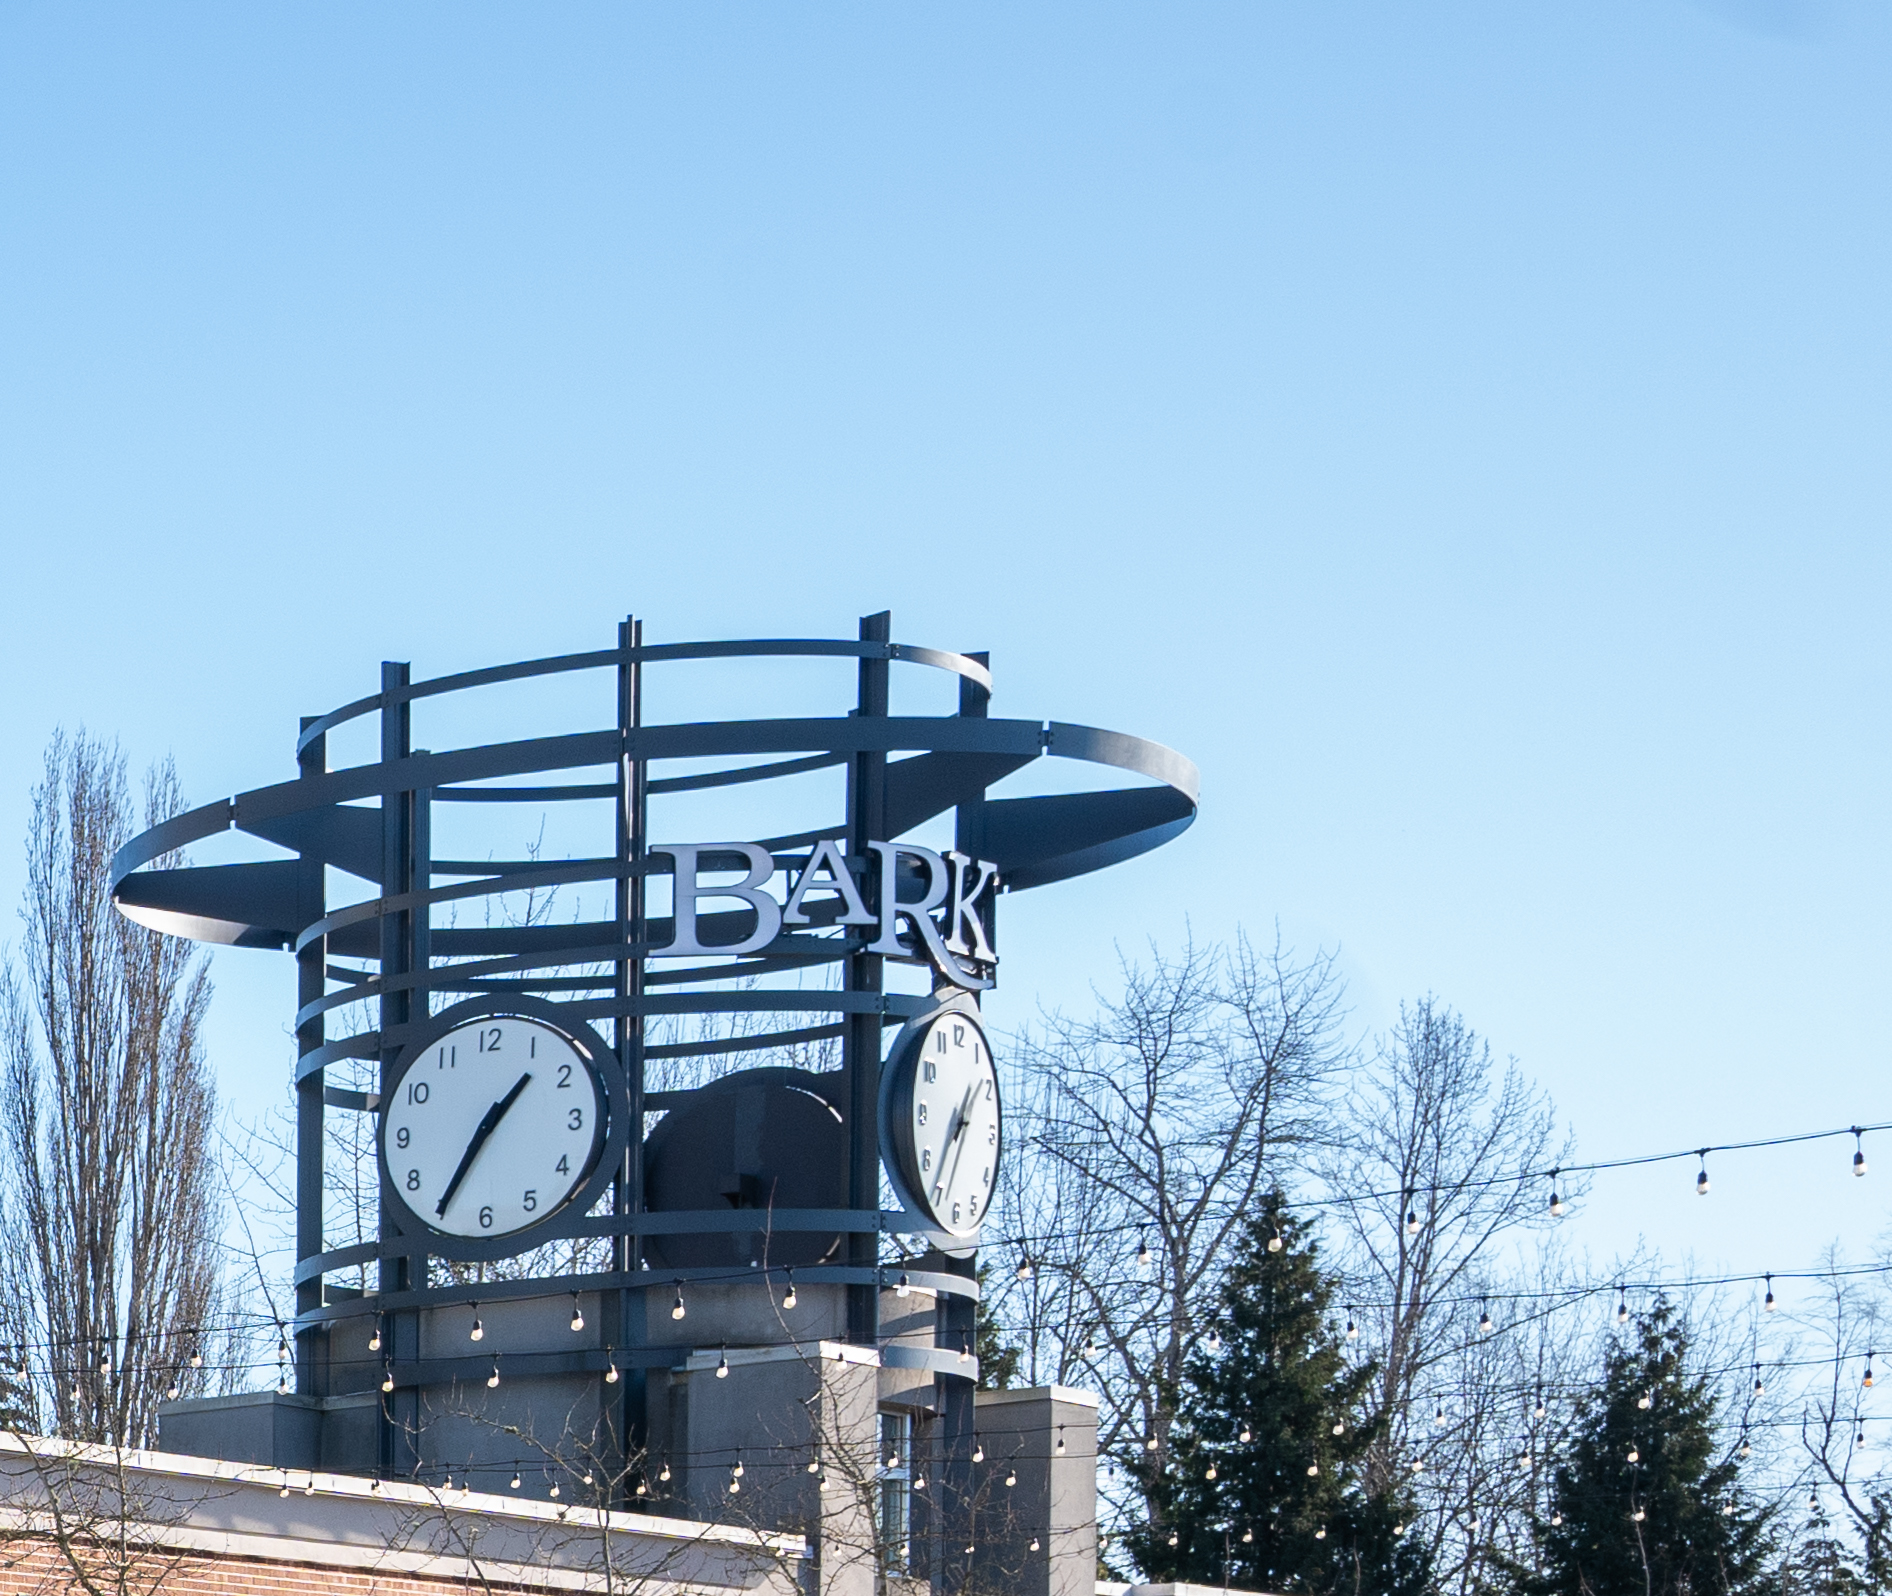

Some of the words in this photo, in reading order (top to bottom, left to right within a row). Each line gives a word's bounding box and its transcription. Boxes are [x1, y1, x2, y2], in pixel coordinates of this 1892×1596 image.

[648, 839, 998, 989] BARK
[479, 1028, 502, 1053] 12
[530, 1036, 536, 1059] 1
[937, 1029, 947, 1055] 11
[953, 1023, 965, 1048] 12
[439, 1045, 456, 1070] 11
[923, 1055, 936, 1084] 10
[556, 1064, 572, 1089] 2
[985, 1076, 993, 1101] 2
[408, 1082, 430, 1106] 10
[567, 1108, 583, 1131] 3
[396, 1127, 410, 1149] 9
[555, 1154, 570, 1176] 4
[982, 1166, 990, 1188] 4
[406, 1169, 421, 1191] 8
[523, 1189, 537, 1212] 5
[479, 1206, 493, 1229] 6
